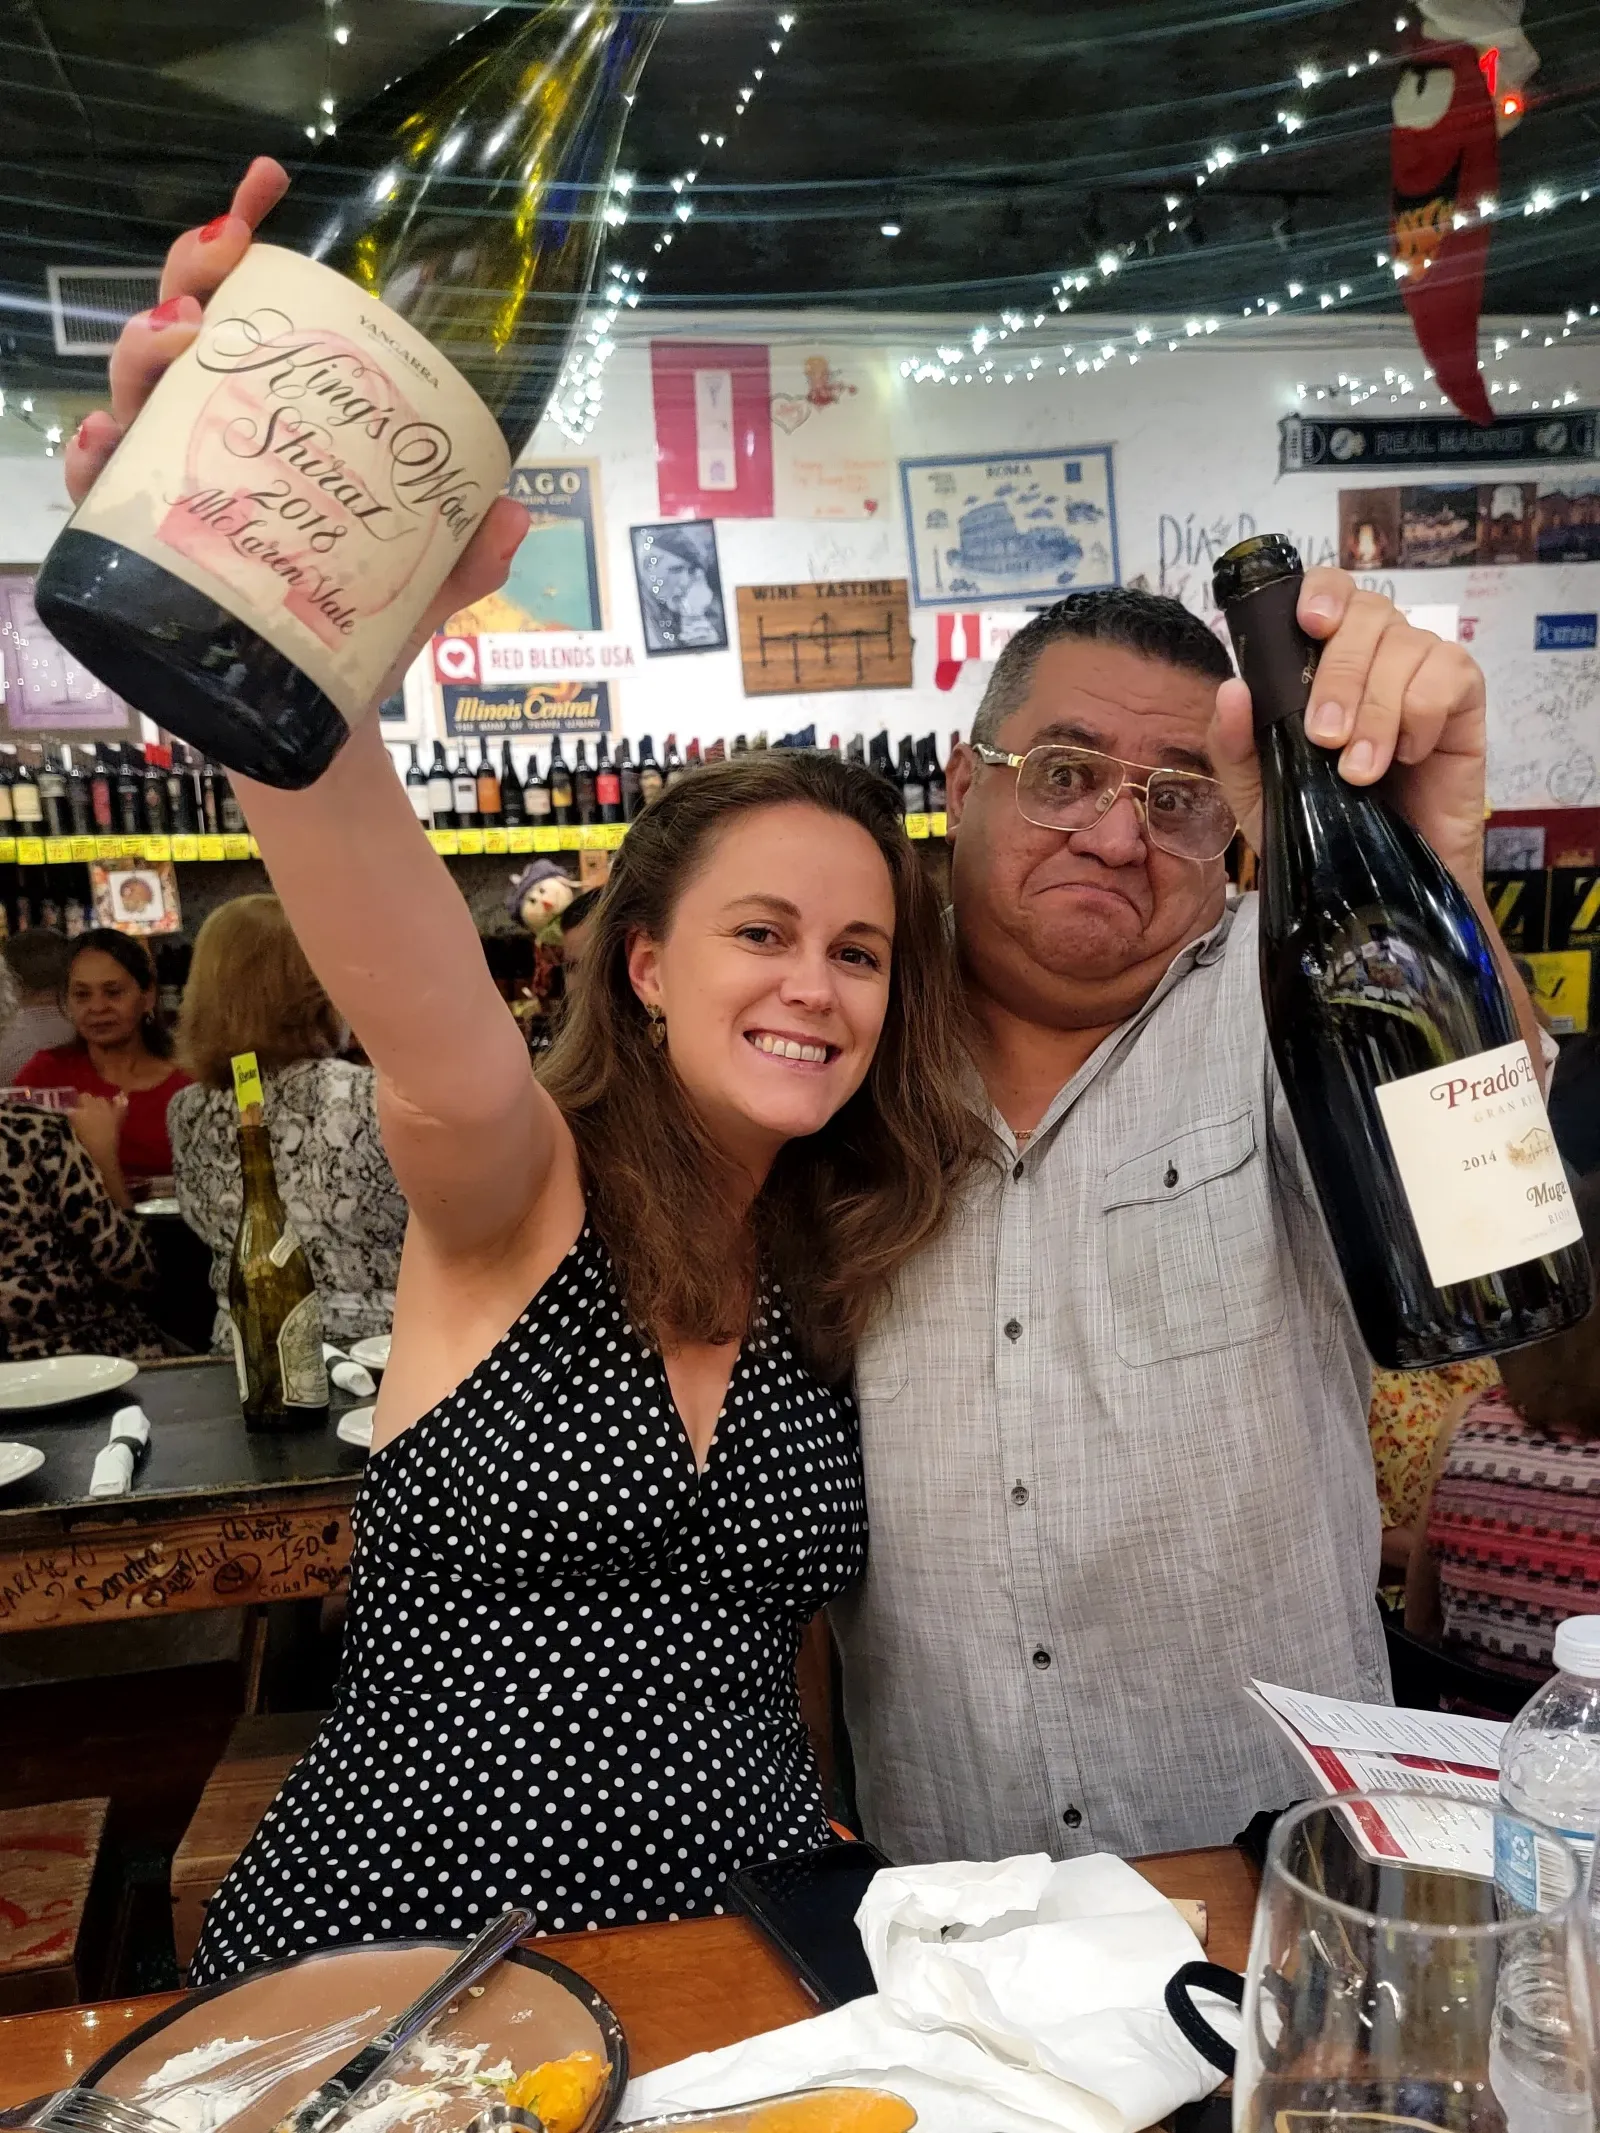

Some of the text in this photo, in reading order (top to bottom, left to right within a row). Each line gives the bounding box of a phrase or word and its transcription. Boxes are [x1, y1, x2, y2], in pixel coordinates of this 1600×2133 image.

[196, 308, 395, 440] King's
[359, 314, 440, 389] YANGARRA
[246, 479, 348, 553] 2018
[163, 489, 357, 635] McLaren Vale
[491, 645, 635, 671] RED BLENDS USA
[454, 694, 599, 722] Illinois Central
[1430, 1064, 1519, 1110] Prado
[1462, 1150, 1498, 1171] 2014
